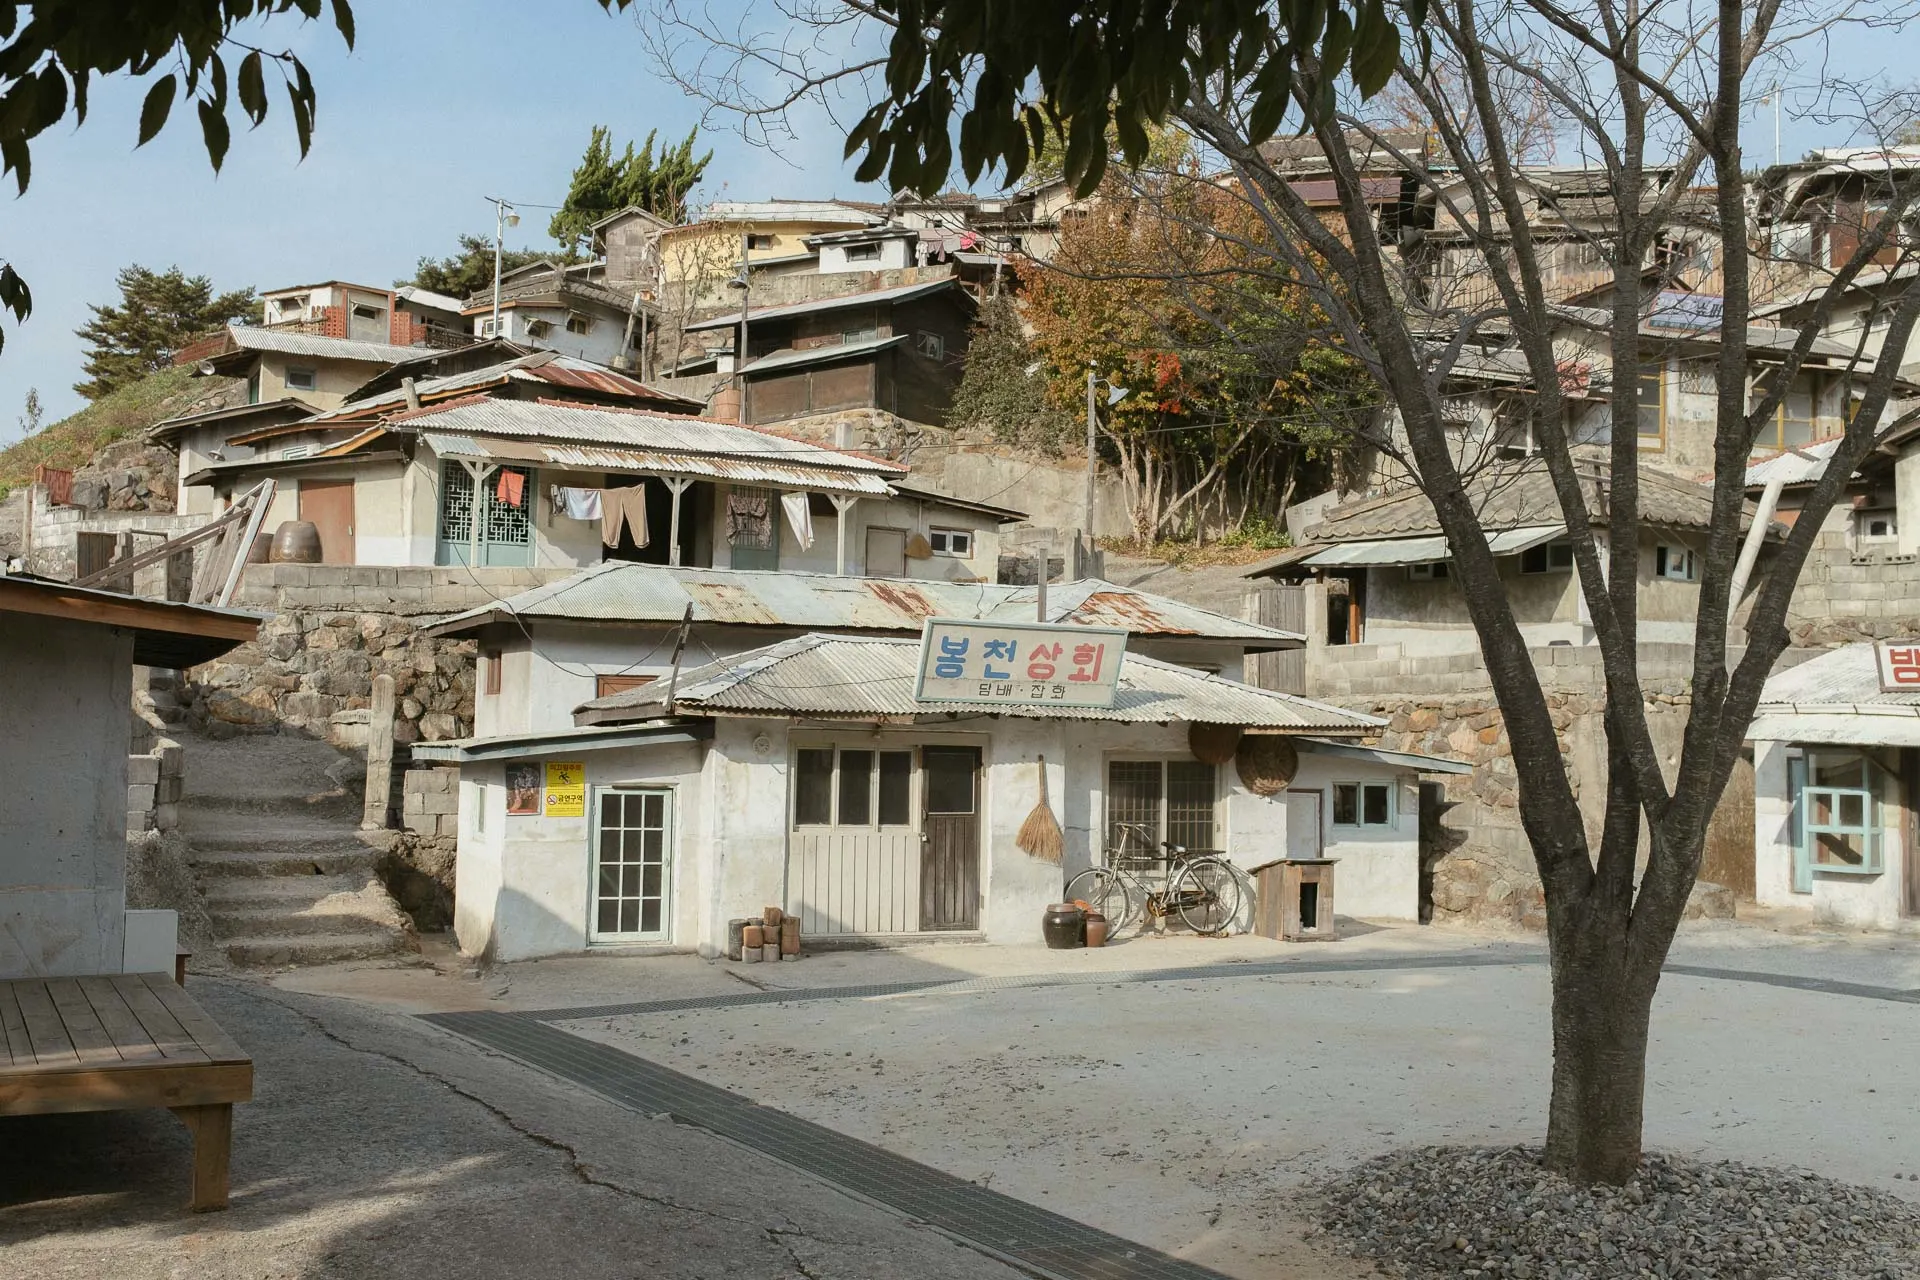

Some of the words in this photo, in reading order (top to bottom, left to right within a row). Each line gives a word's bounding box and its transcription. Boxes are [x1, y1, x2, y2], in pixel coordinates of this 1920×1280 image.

[935, 636, 1104, 681] 봉천상회
[979, 683, 1012, 697] 담배
[1031, 683, 1066, 699] 잡화
